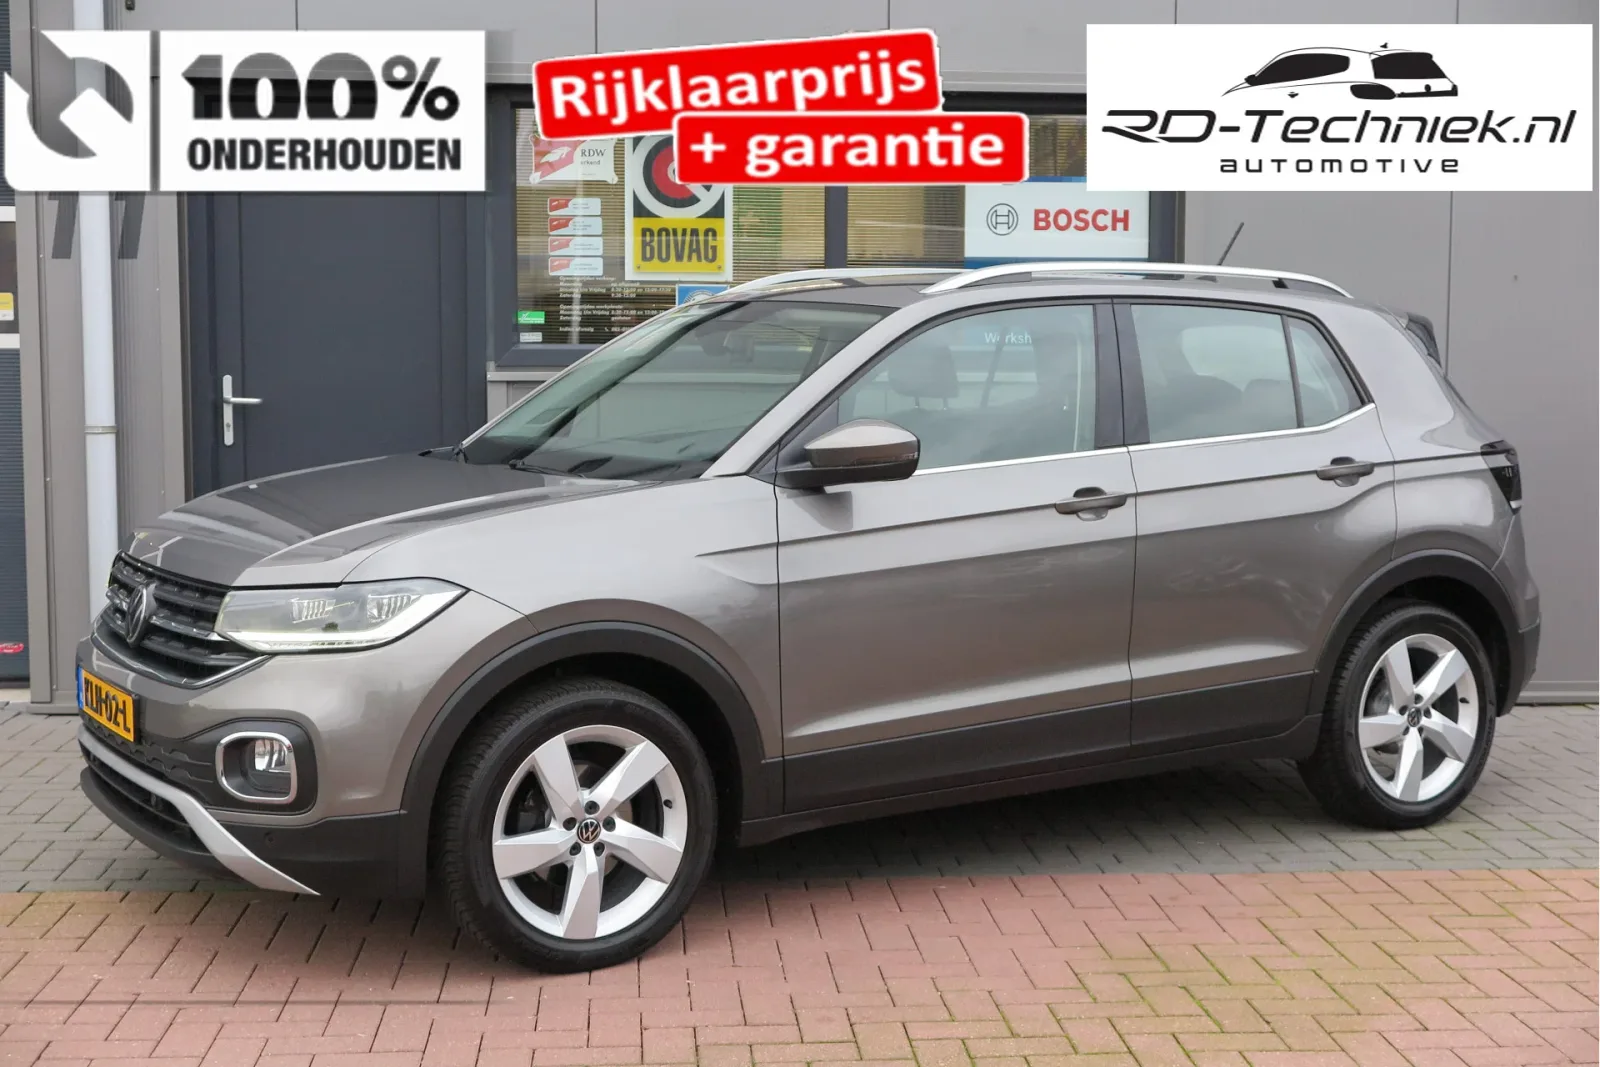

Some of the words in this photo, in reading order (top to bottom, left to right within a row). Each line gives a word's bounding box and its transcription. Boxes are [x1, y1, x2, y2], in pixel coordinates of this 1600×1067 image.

[581, 149, 607, 157] RDW
[1033, 208, 1131, 233] BOSCH
[640, 226, 719, 264] BOVAG
